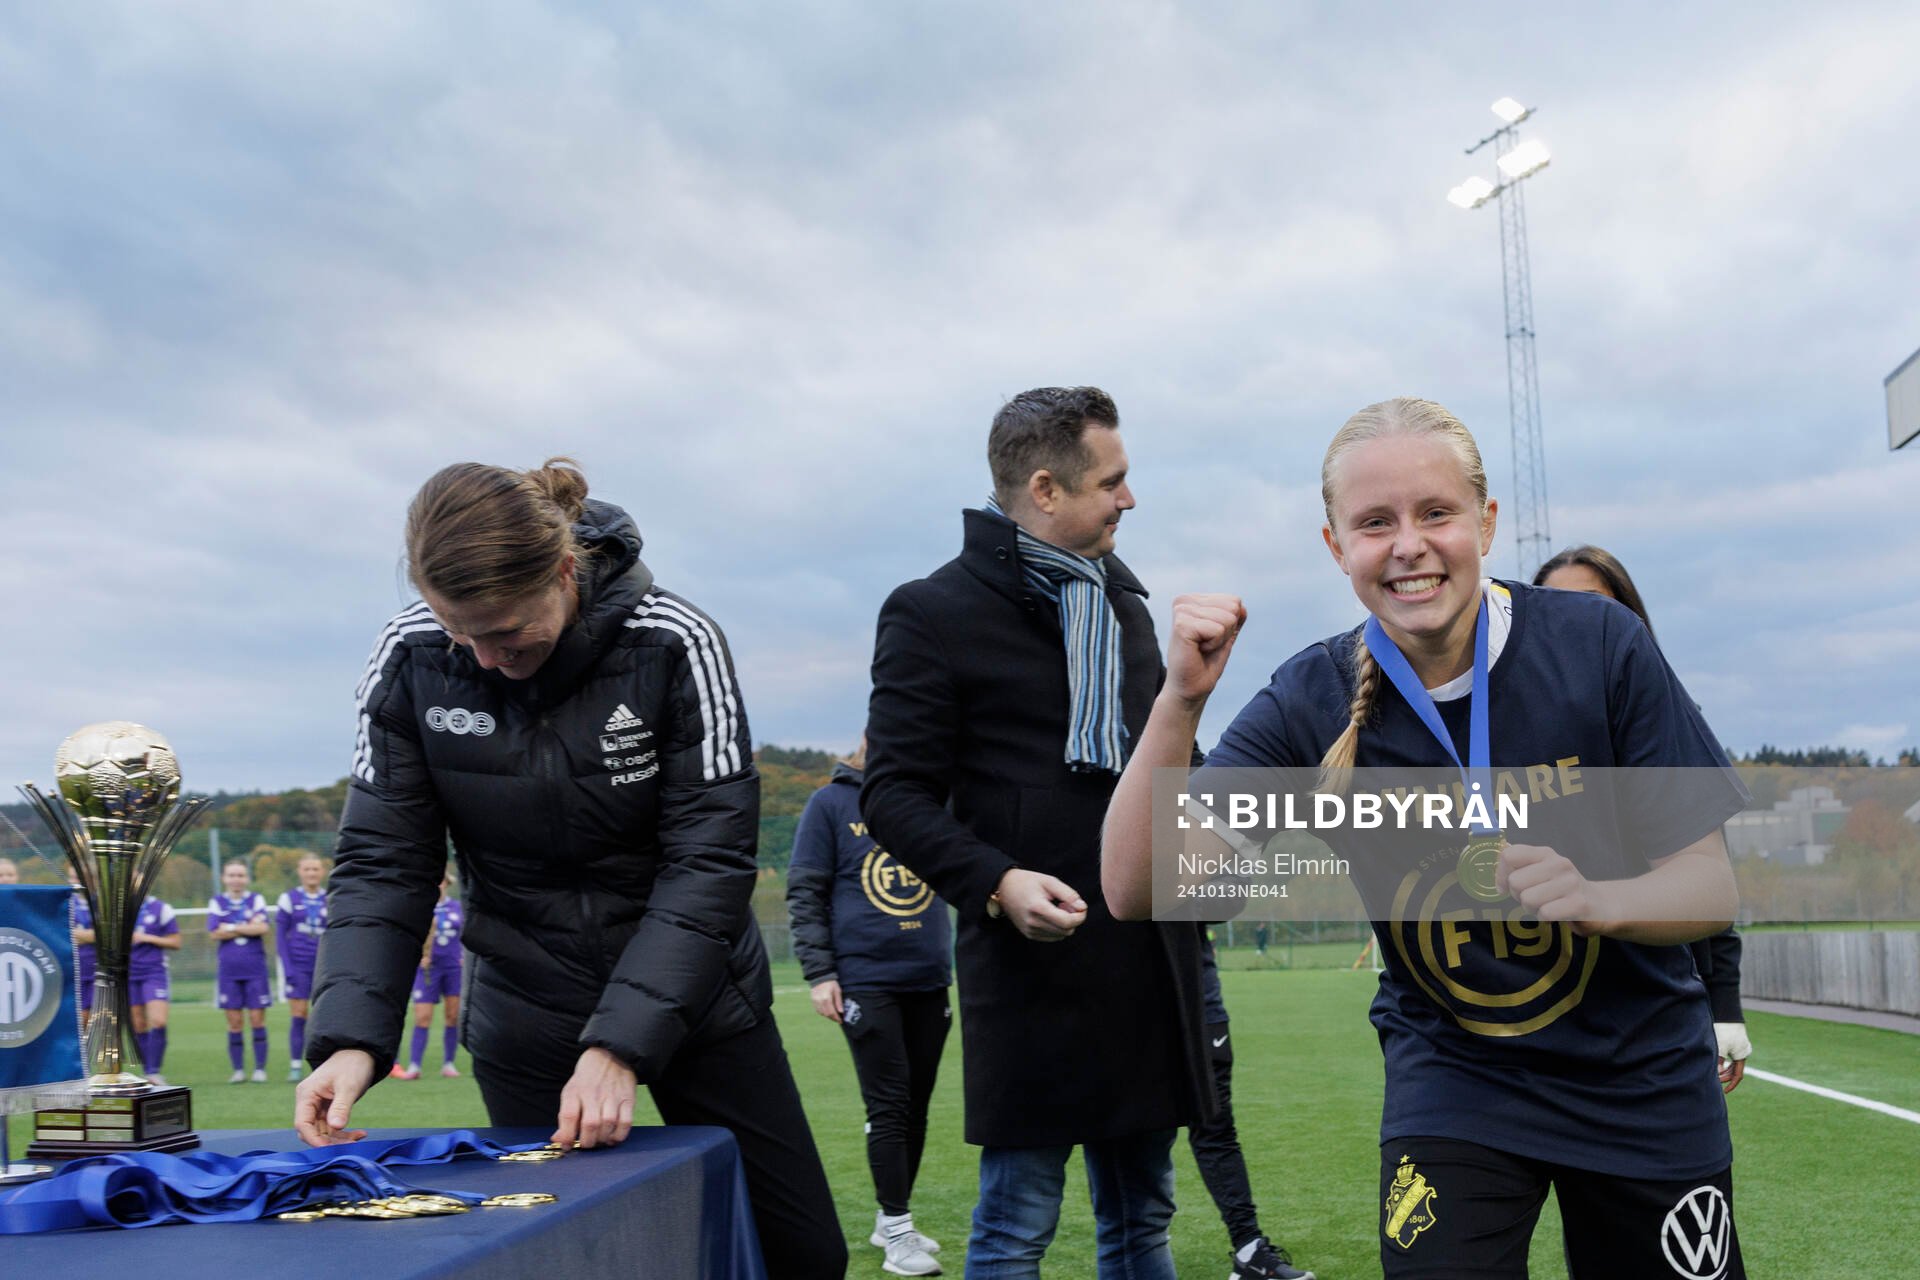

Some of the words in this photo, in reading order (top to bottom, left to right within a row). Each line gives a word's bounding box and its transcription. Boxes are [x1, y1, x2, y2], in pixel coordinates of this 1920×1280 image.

[604, 718, 644, 731] adidas
[624, 750, 657, 766] OBOS
[611, 762, 660, 786] PULSEN
[1440, 906, 1553, 968] F19
